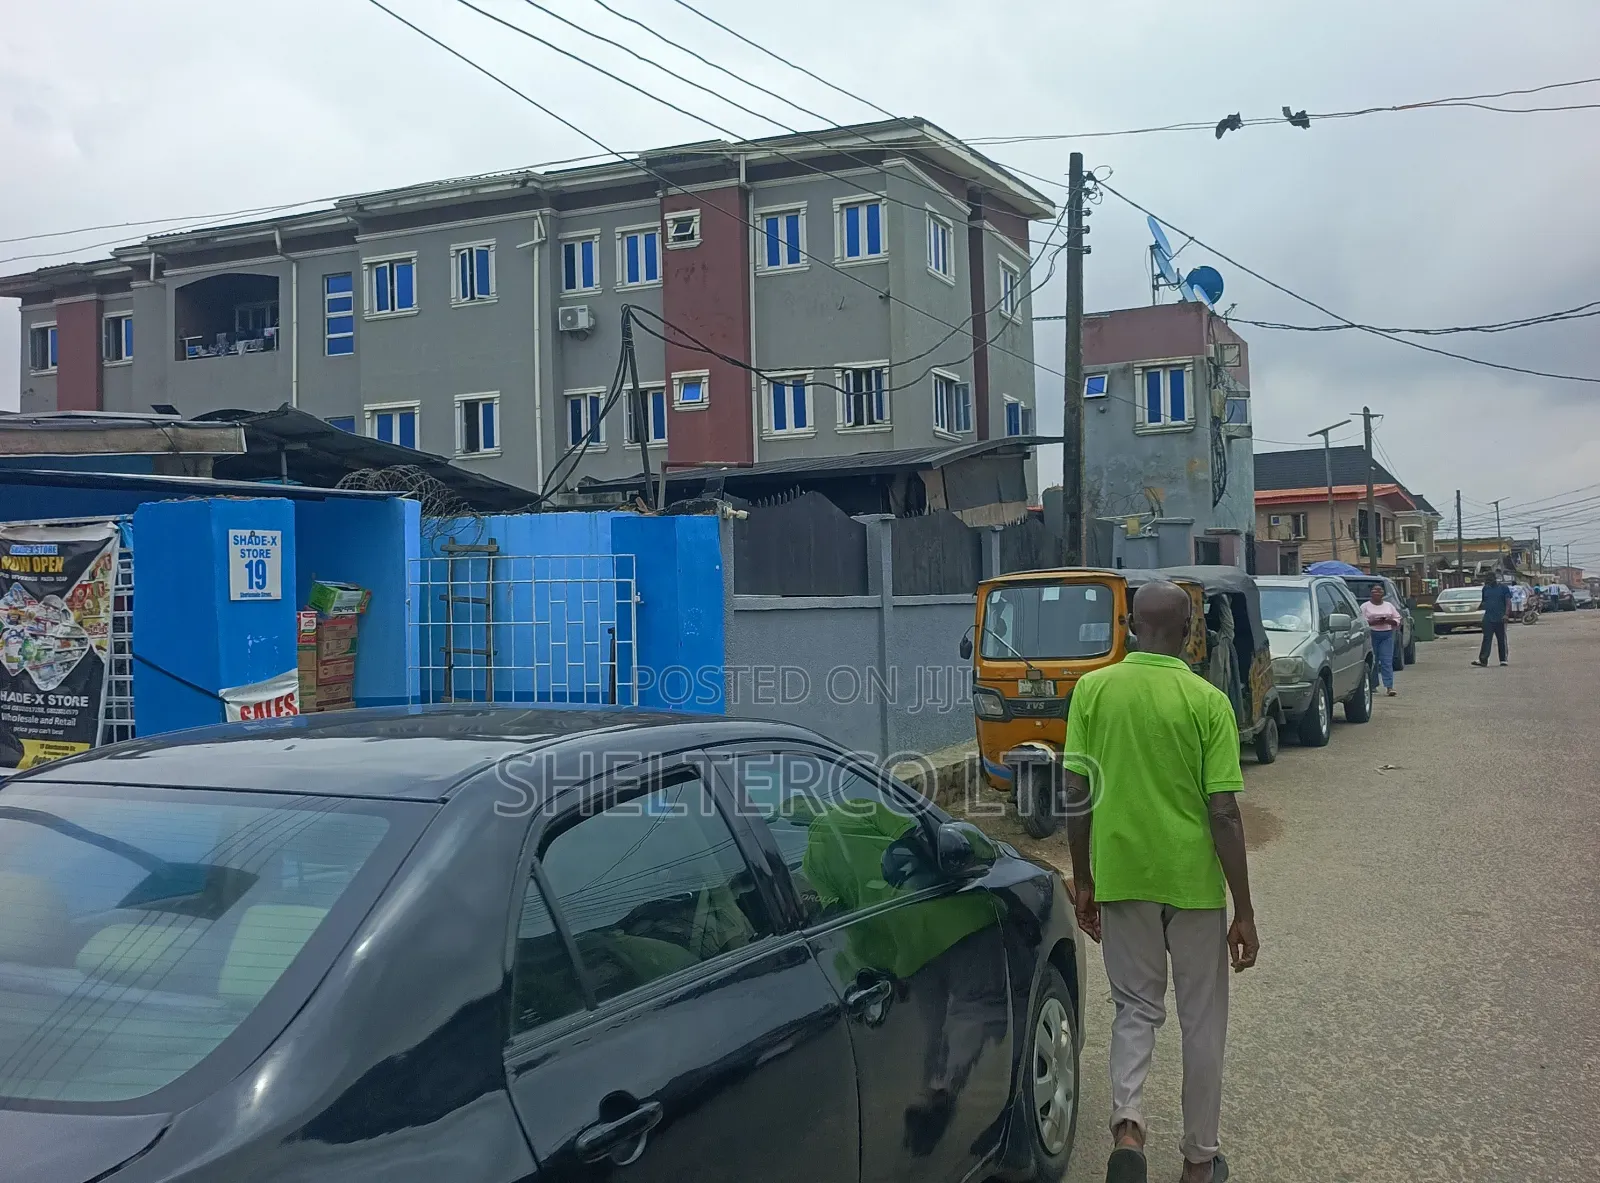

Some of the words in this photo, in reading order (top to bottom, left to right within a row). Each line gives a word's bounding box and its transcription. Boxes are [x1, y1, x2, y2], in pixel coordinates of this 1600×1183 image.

[233, 535, 277, 546] SHADE-X
[240, 549, 271, 558] STORE
[1, 556, 30, 572] NOW
[32, 556, 64, 573] OPEN
[245, 559, 266, 590] 19
[0, 690, 45, 704] HADE-X
[48, 694, 89, 707] STORE
[1, 712, 39, 724] Wholesale
[40, 716, 54, 725] and
[54, 716, 76, 726] Retail
